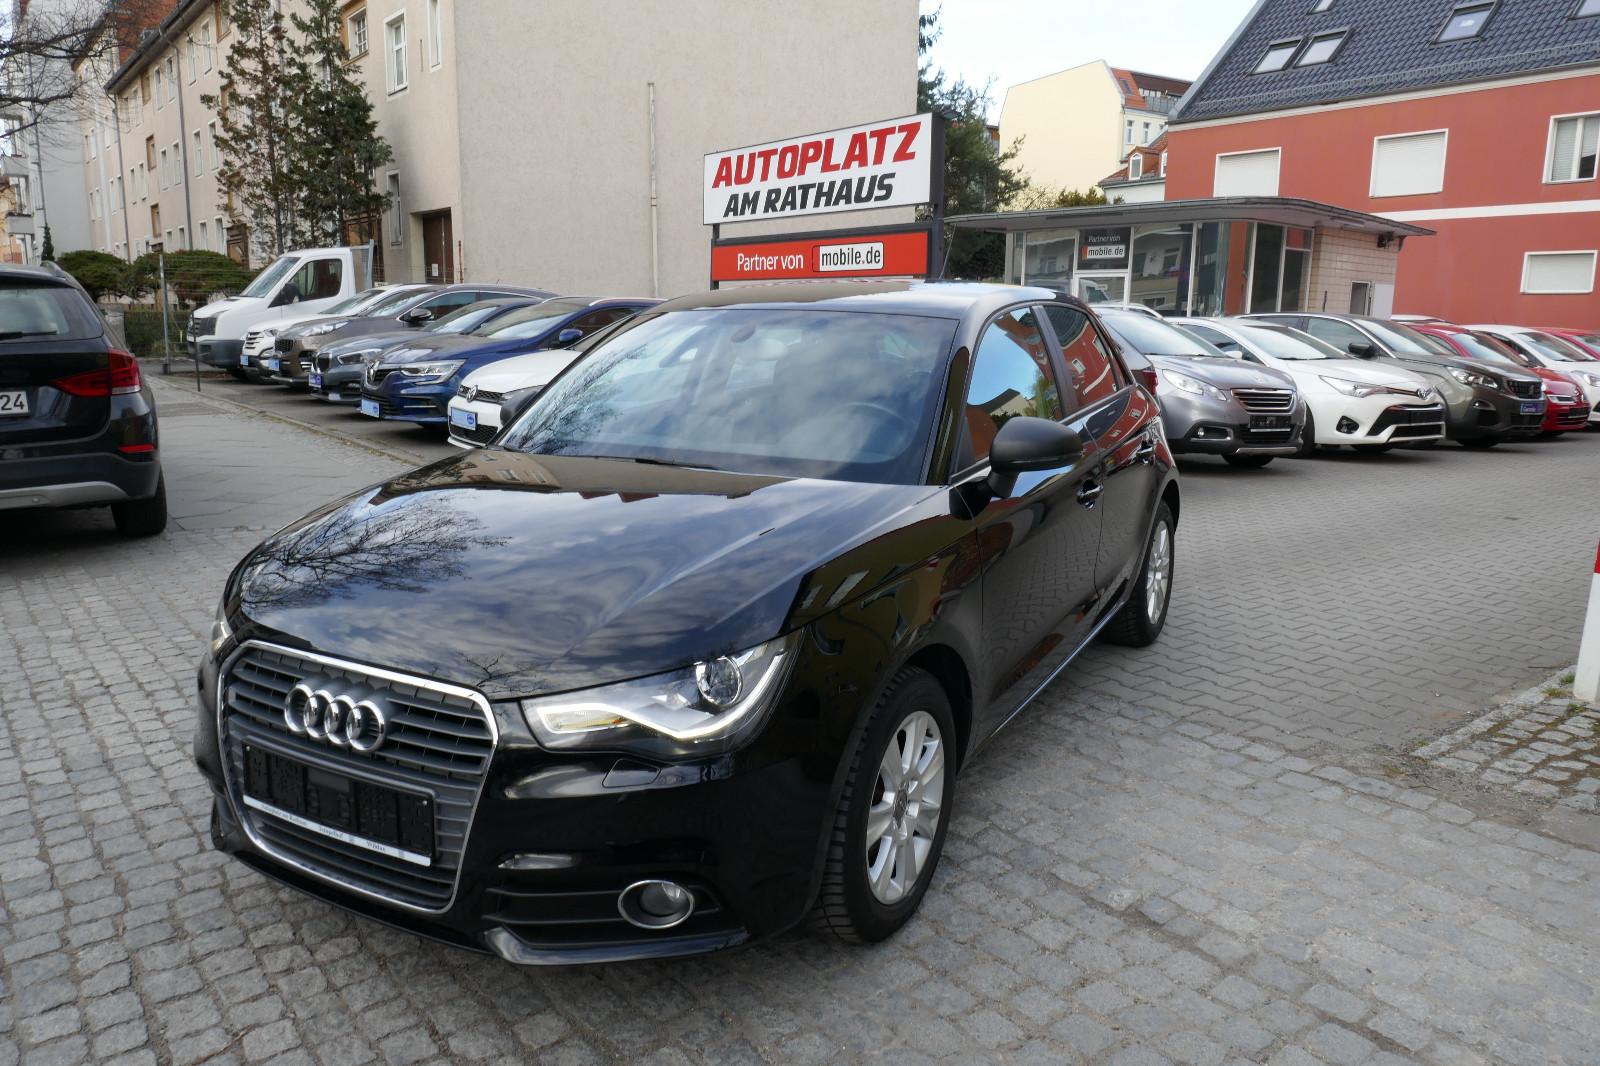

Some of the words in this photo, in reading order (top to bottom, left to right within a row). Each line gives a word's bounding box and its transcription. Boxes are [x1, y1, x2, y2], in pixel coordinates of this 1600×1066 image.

[712, 121, 922, 188] AUTOPLATZ
[723, 190, 760, 217] AM
[763, 172, 896, 214] RATHAUS
[737, 252, 779, 271] Partner
[780, 253, 804, 270] von
[821, 246, 881, 266] mobile.de
[1088, 247, 1123, 256] mobile.de
